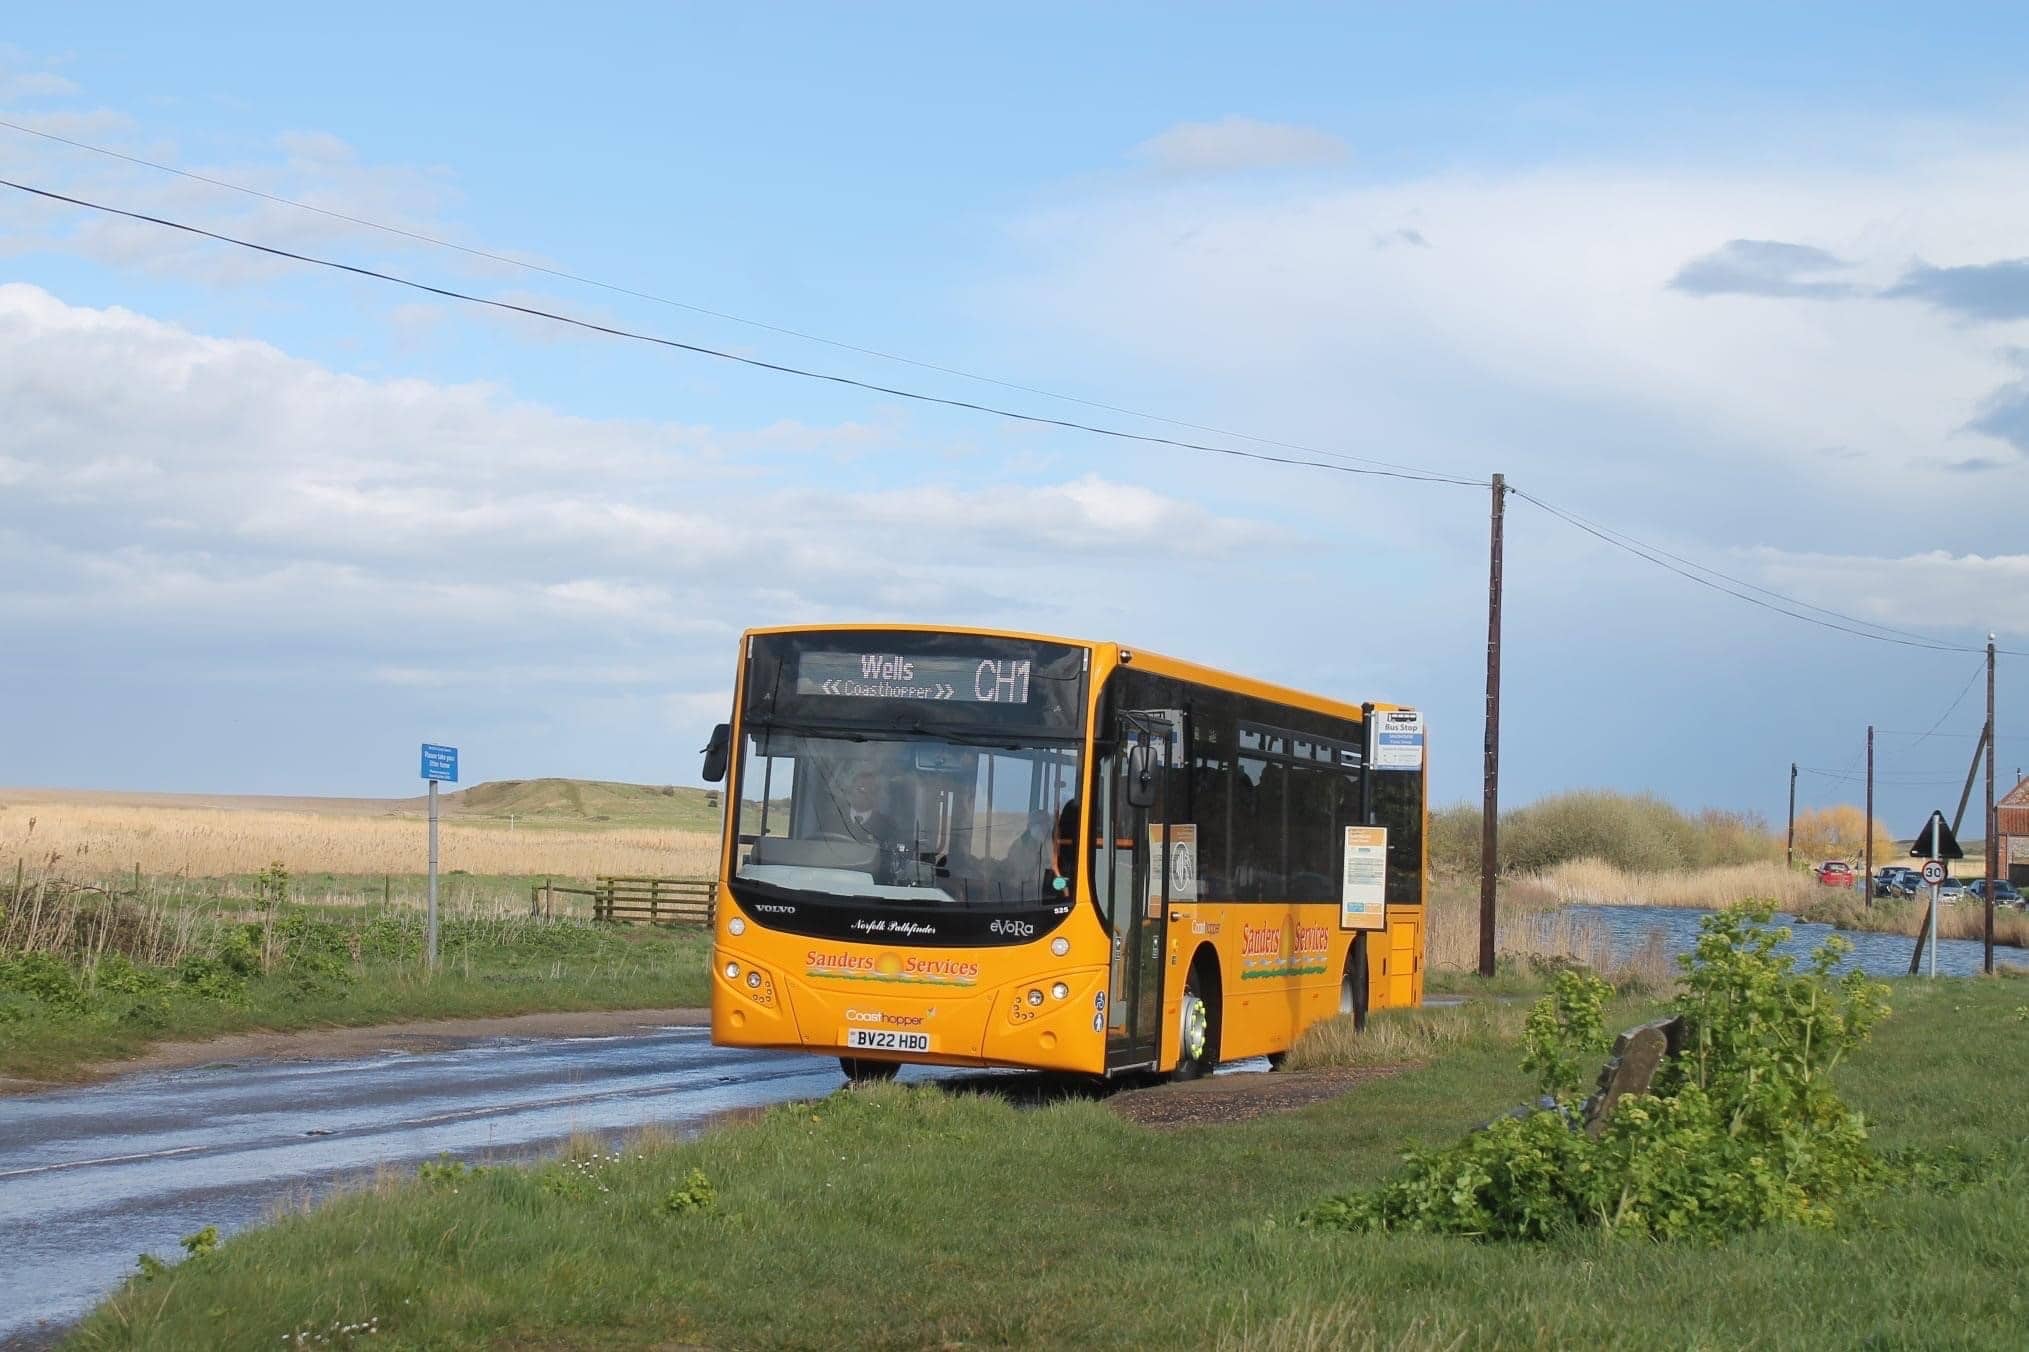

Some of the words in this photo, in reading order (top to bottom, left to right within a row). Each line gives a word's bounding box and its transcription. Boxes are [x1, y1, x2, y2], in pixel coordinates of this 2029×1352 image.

[861, 655, 914, 681] Wells
[974, 659, 1031, 704] CH1
[1400, 724, 1417, 732] Stop
[1926, 868, 1941, 877] 30
[755, 904, 795, 914] VOLVO
[851, 919, 885, 934] Norfolk
[887, 920, 936, 937] Pathfinder
[1242, 921, 1280, 956] Sanders
[1294, 920, 1329, 953] Services
[806, 951, 873, 969] Sanders
[905, 957, 978, 976] Services
[846, 1009, 925, 1027] Coasthopper
[857, 1031, 895, 1048] BV22
